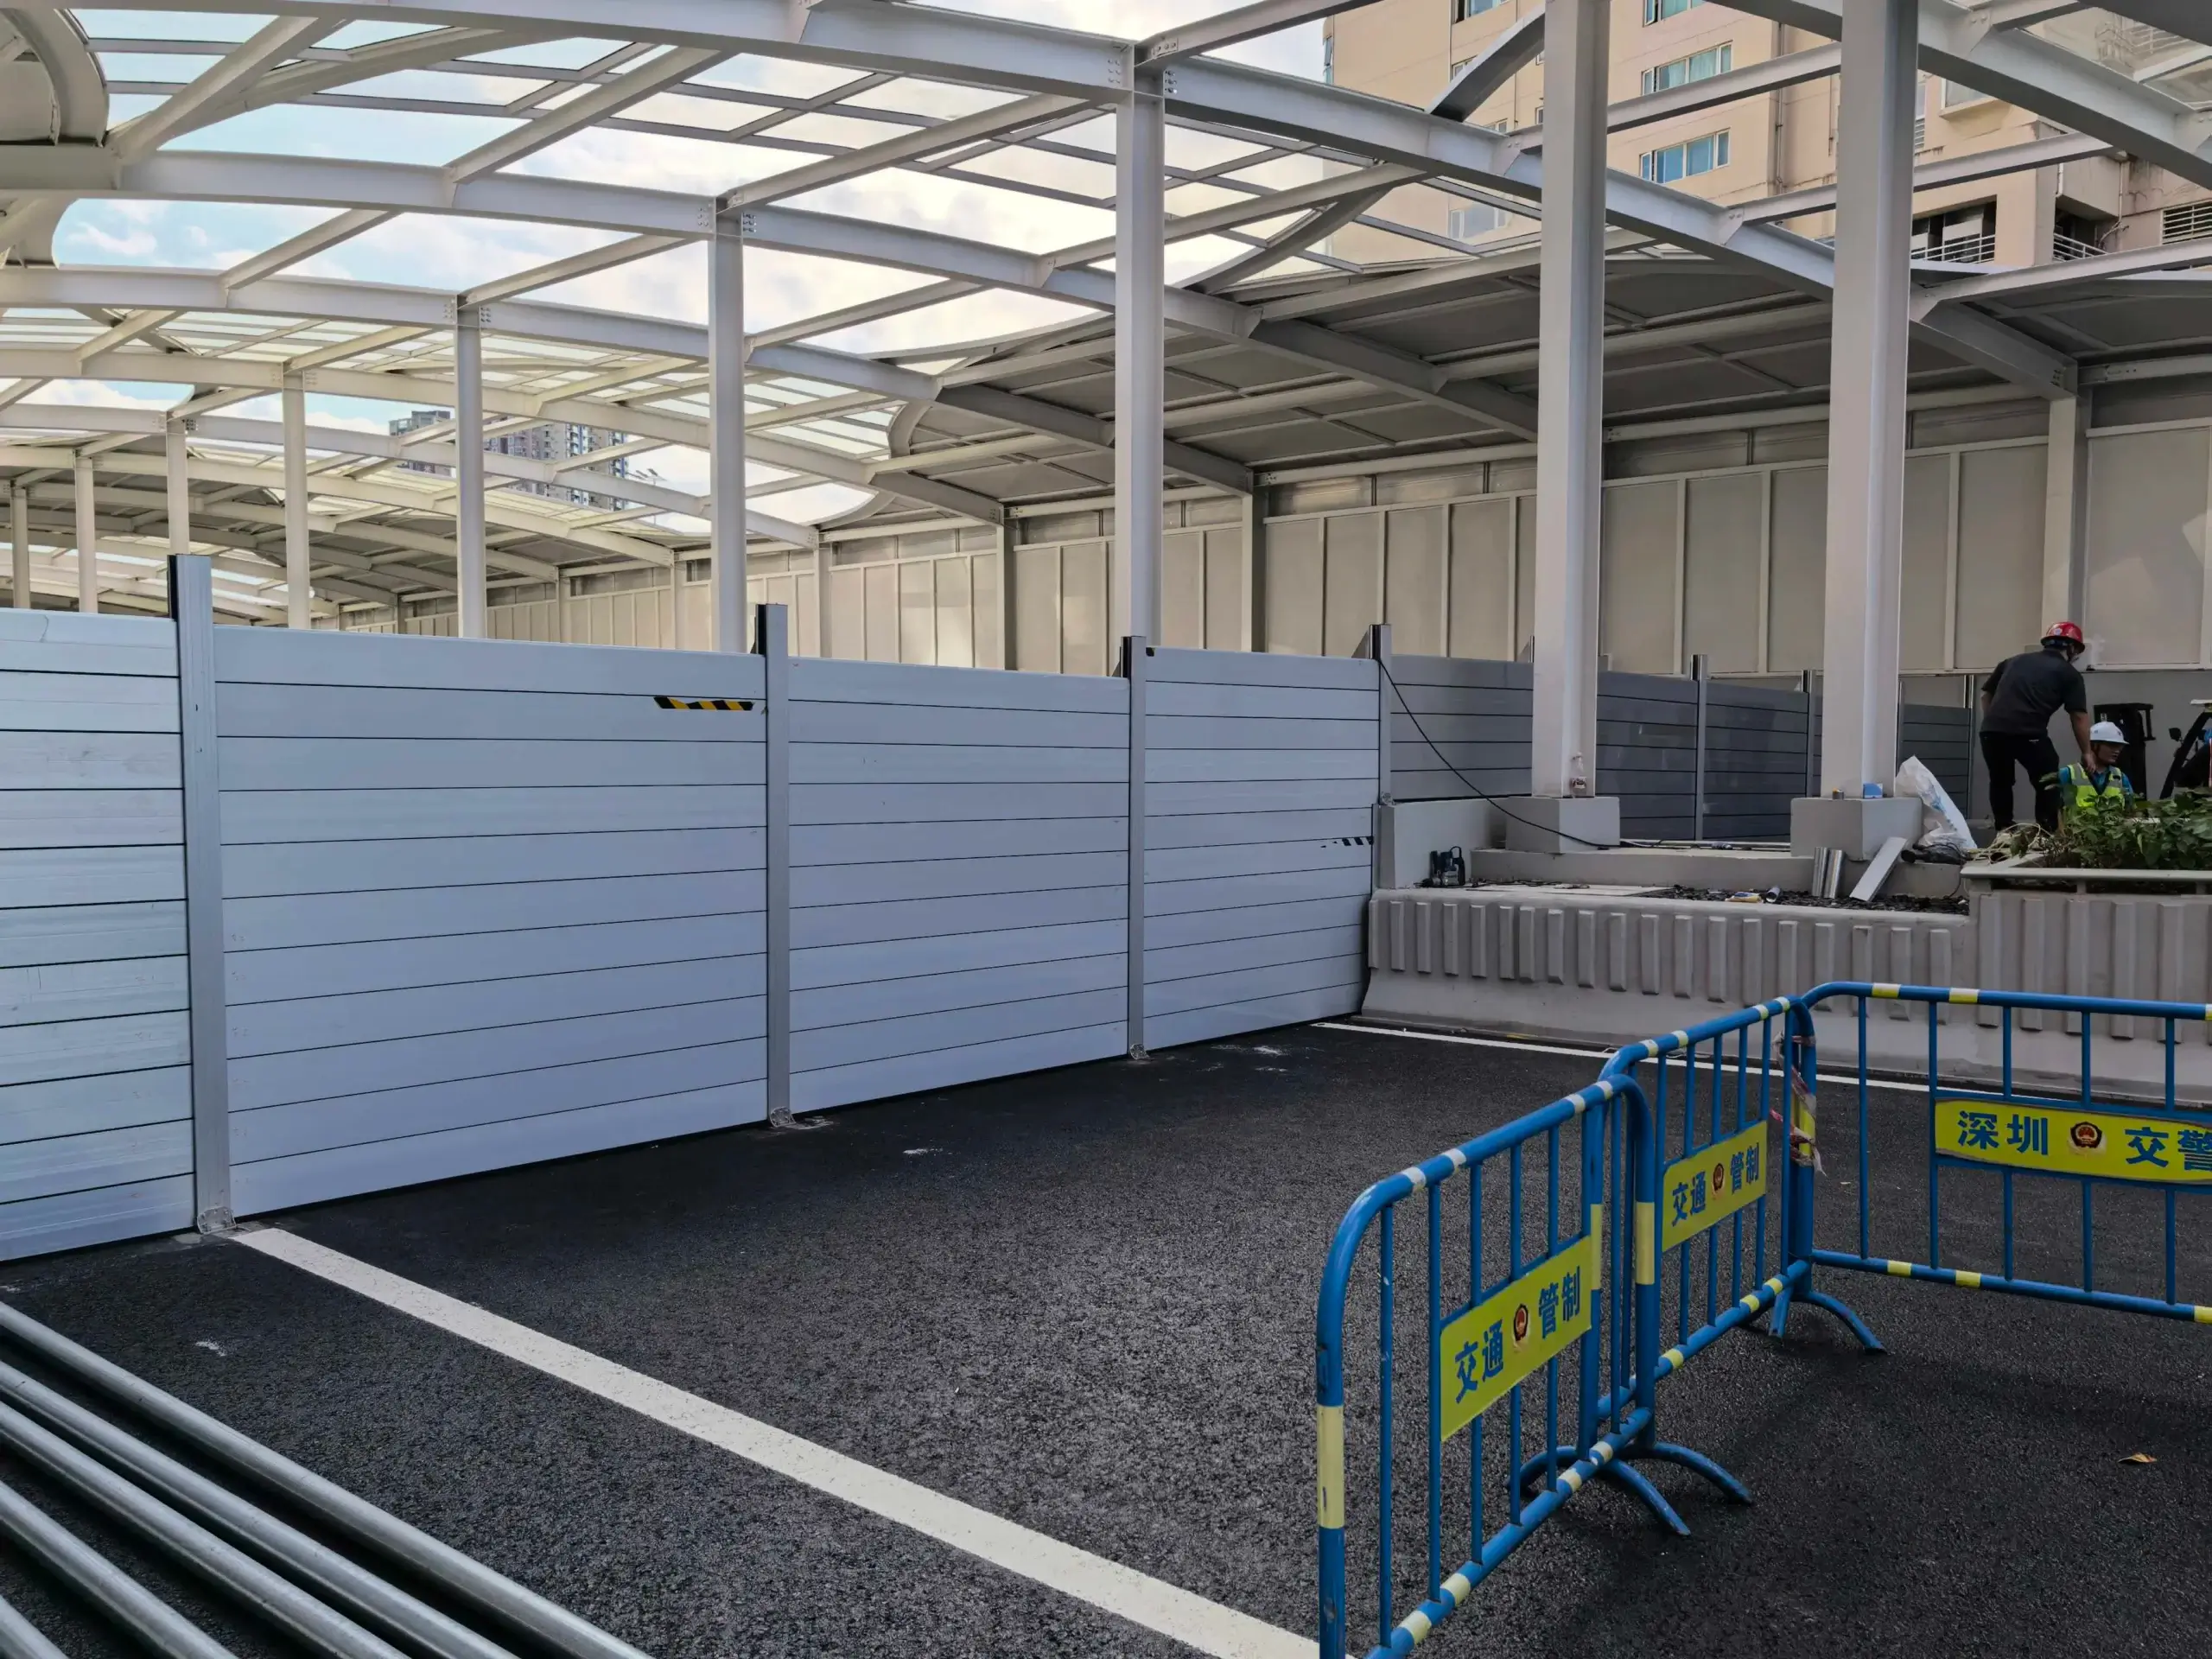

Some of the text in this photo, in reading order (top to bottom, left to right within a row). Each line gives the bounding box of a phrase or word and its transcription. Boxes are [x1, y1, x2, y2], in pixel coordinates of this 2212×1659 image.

[1956, 1110, 2049, 1156] 深圳
[1671, 1142, 1759, 1227] 交通 管制
[1454, 1265, 1580, 1404] 交通 管制
